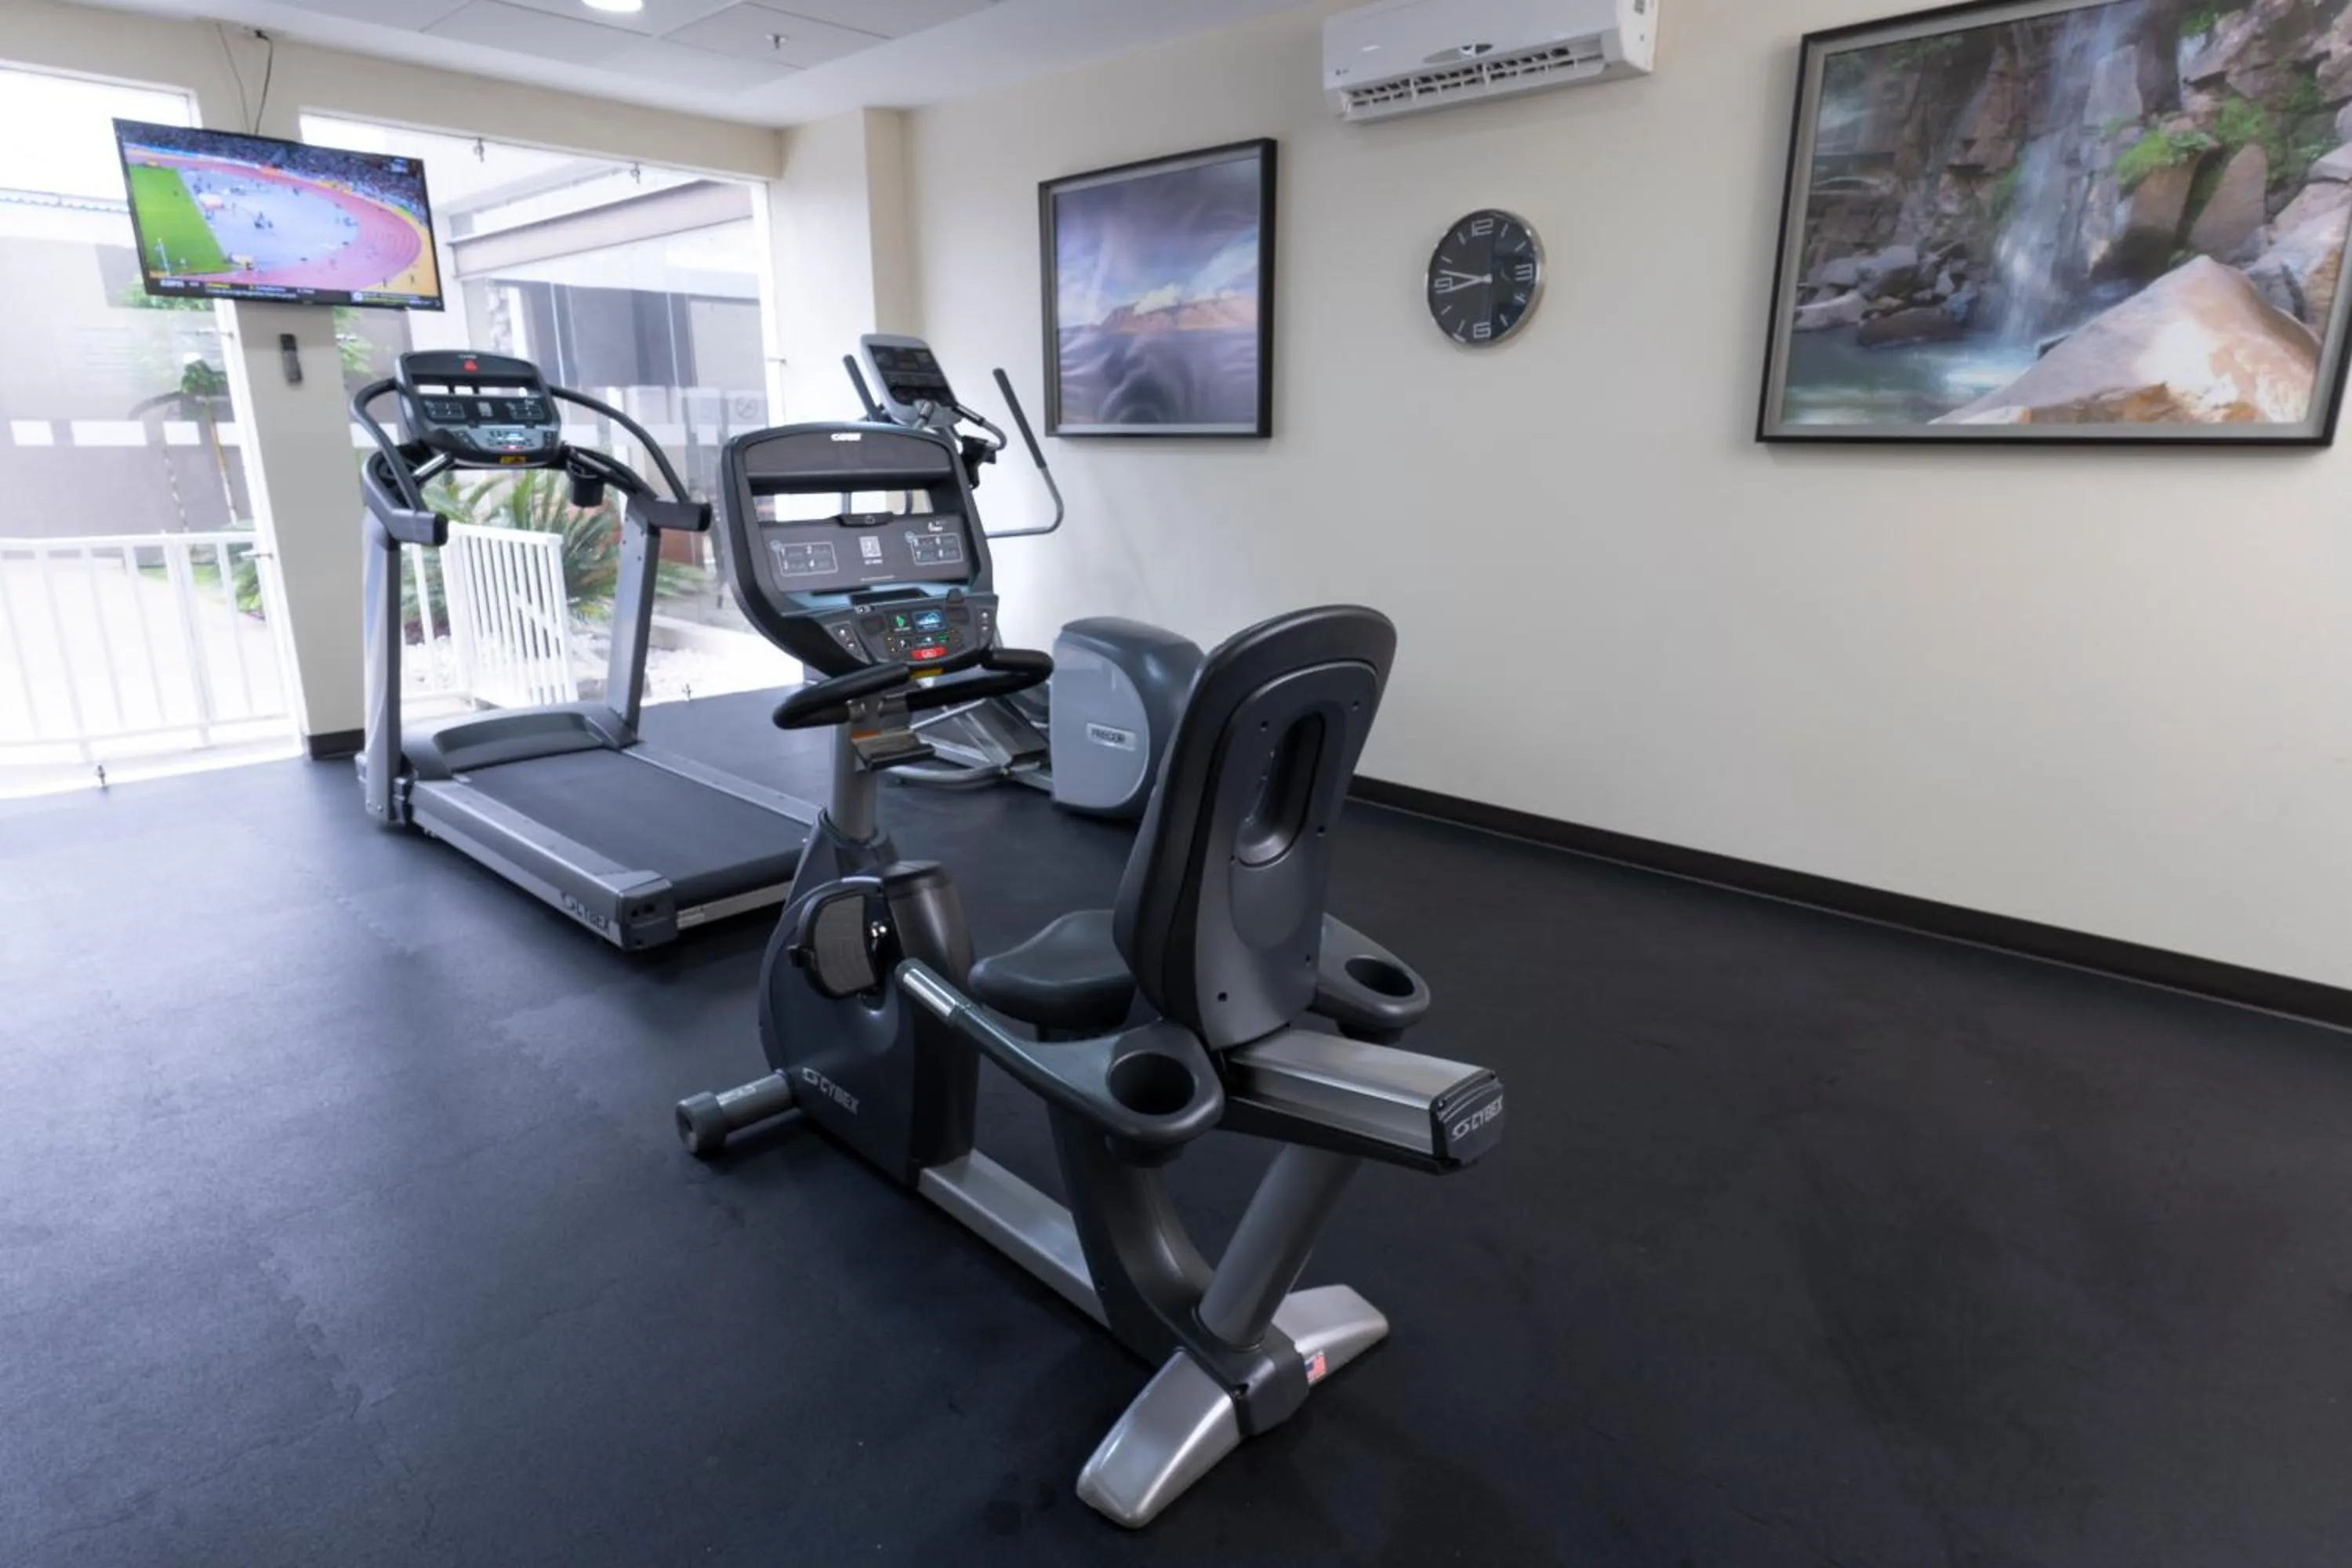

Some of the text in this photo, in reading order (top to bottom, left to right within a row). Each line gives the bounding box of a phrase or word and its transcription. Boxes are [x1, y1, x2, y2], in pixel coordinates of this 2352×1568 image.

[1515, 263, 1534, 282] 3
[1434, 277, 1454, 295] 9
[1473, 321, 1491, 339] 6
[819, 1074, 861, 1115] CYBEX
[1470, 1094, 1504, 1131] CYBEX
